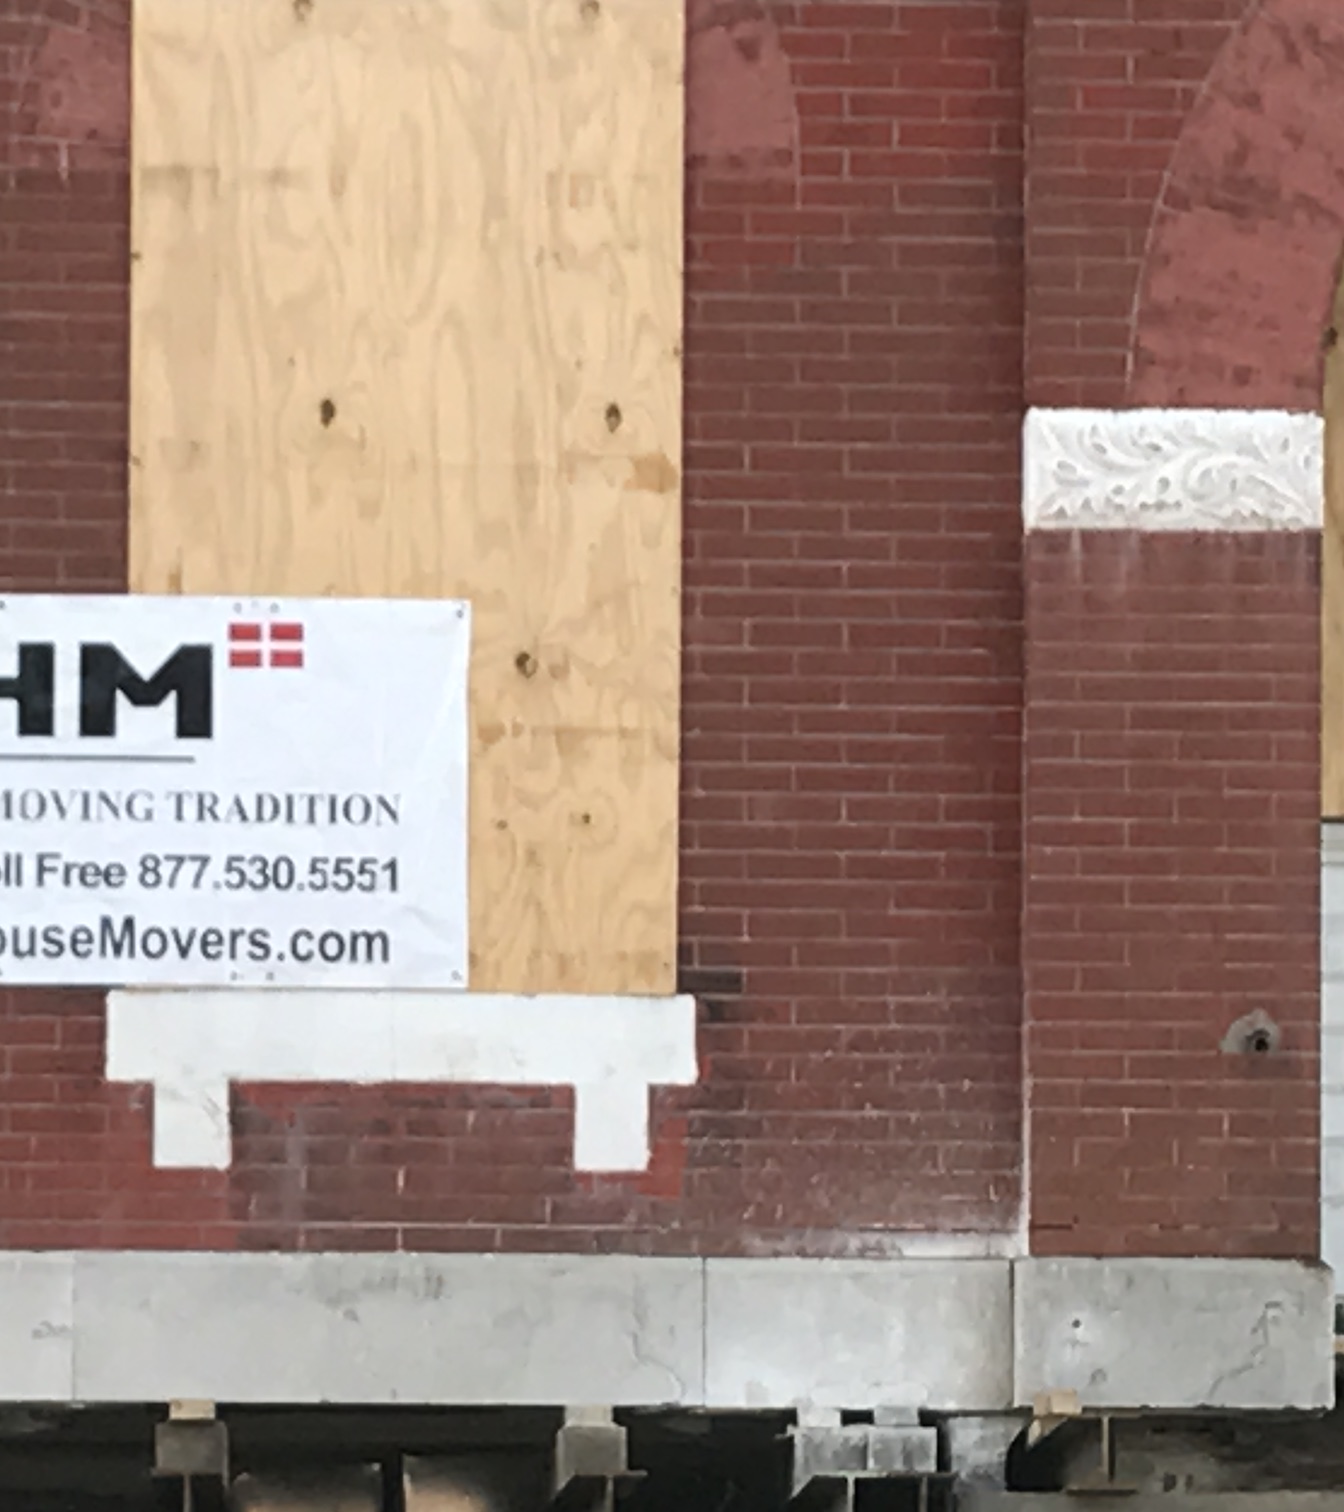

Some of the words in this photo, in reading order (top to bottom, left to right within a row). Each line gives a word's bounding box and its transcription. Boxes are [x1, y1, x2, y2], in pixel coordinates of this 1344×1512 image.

[170, 790, 403, 827] TRADITION
[34, 851, 128, 891] Free
[136, 853, 400, 895] 877.530.5551
